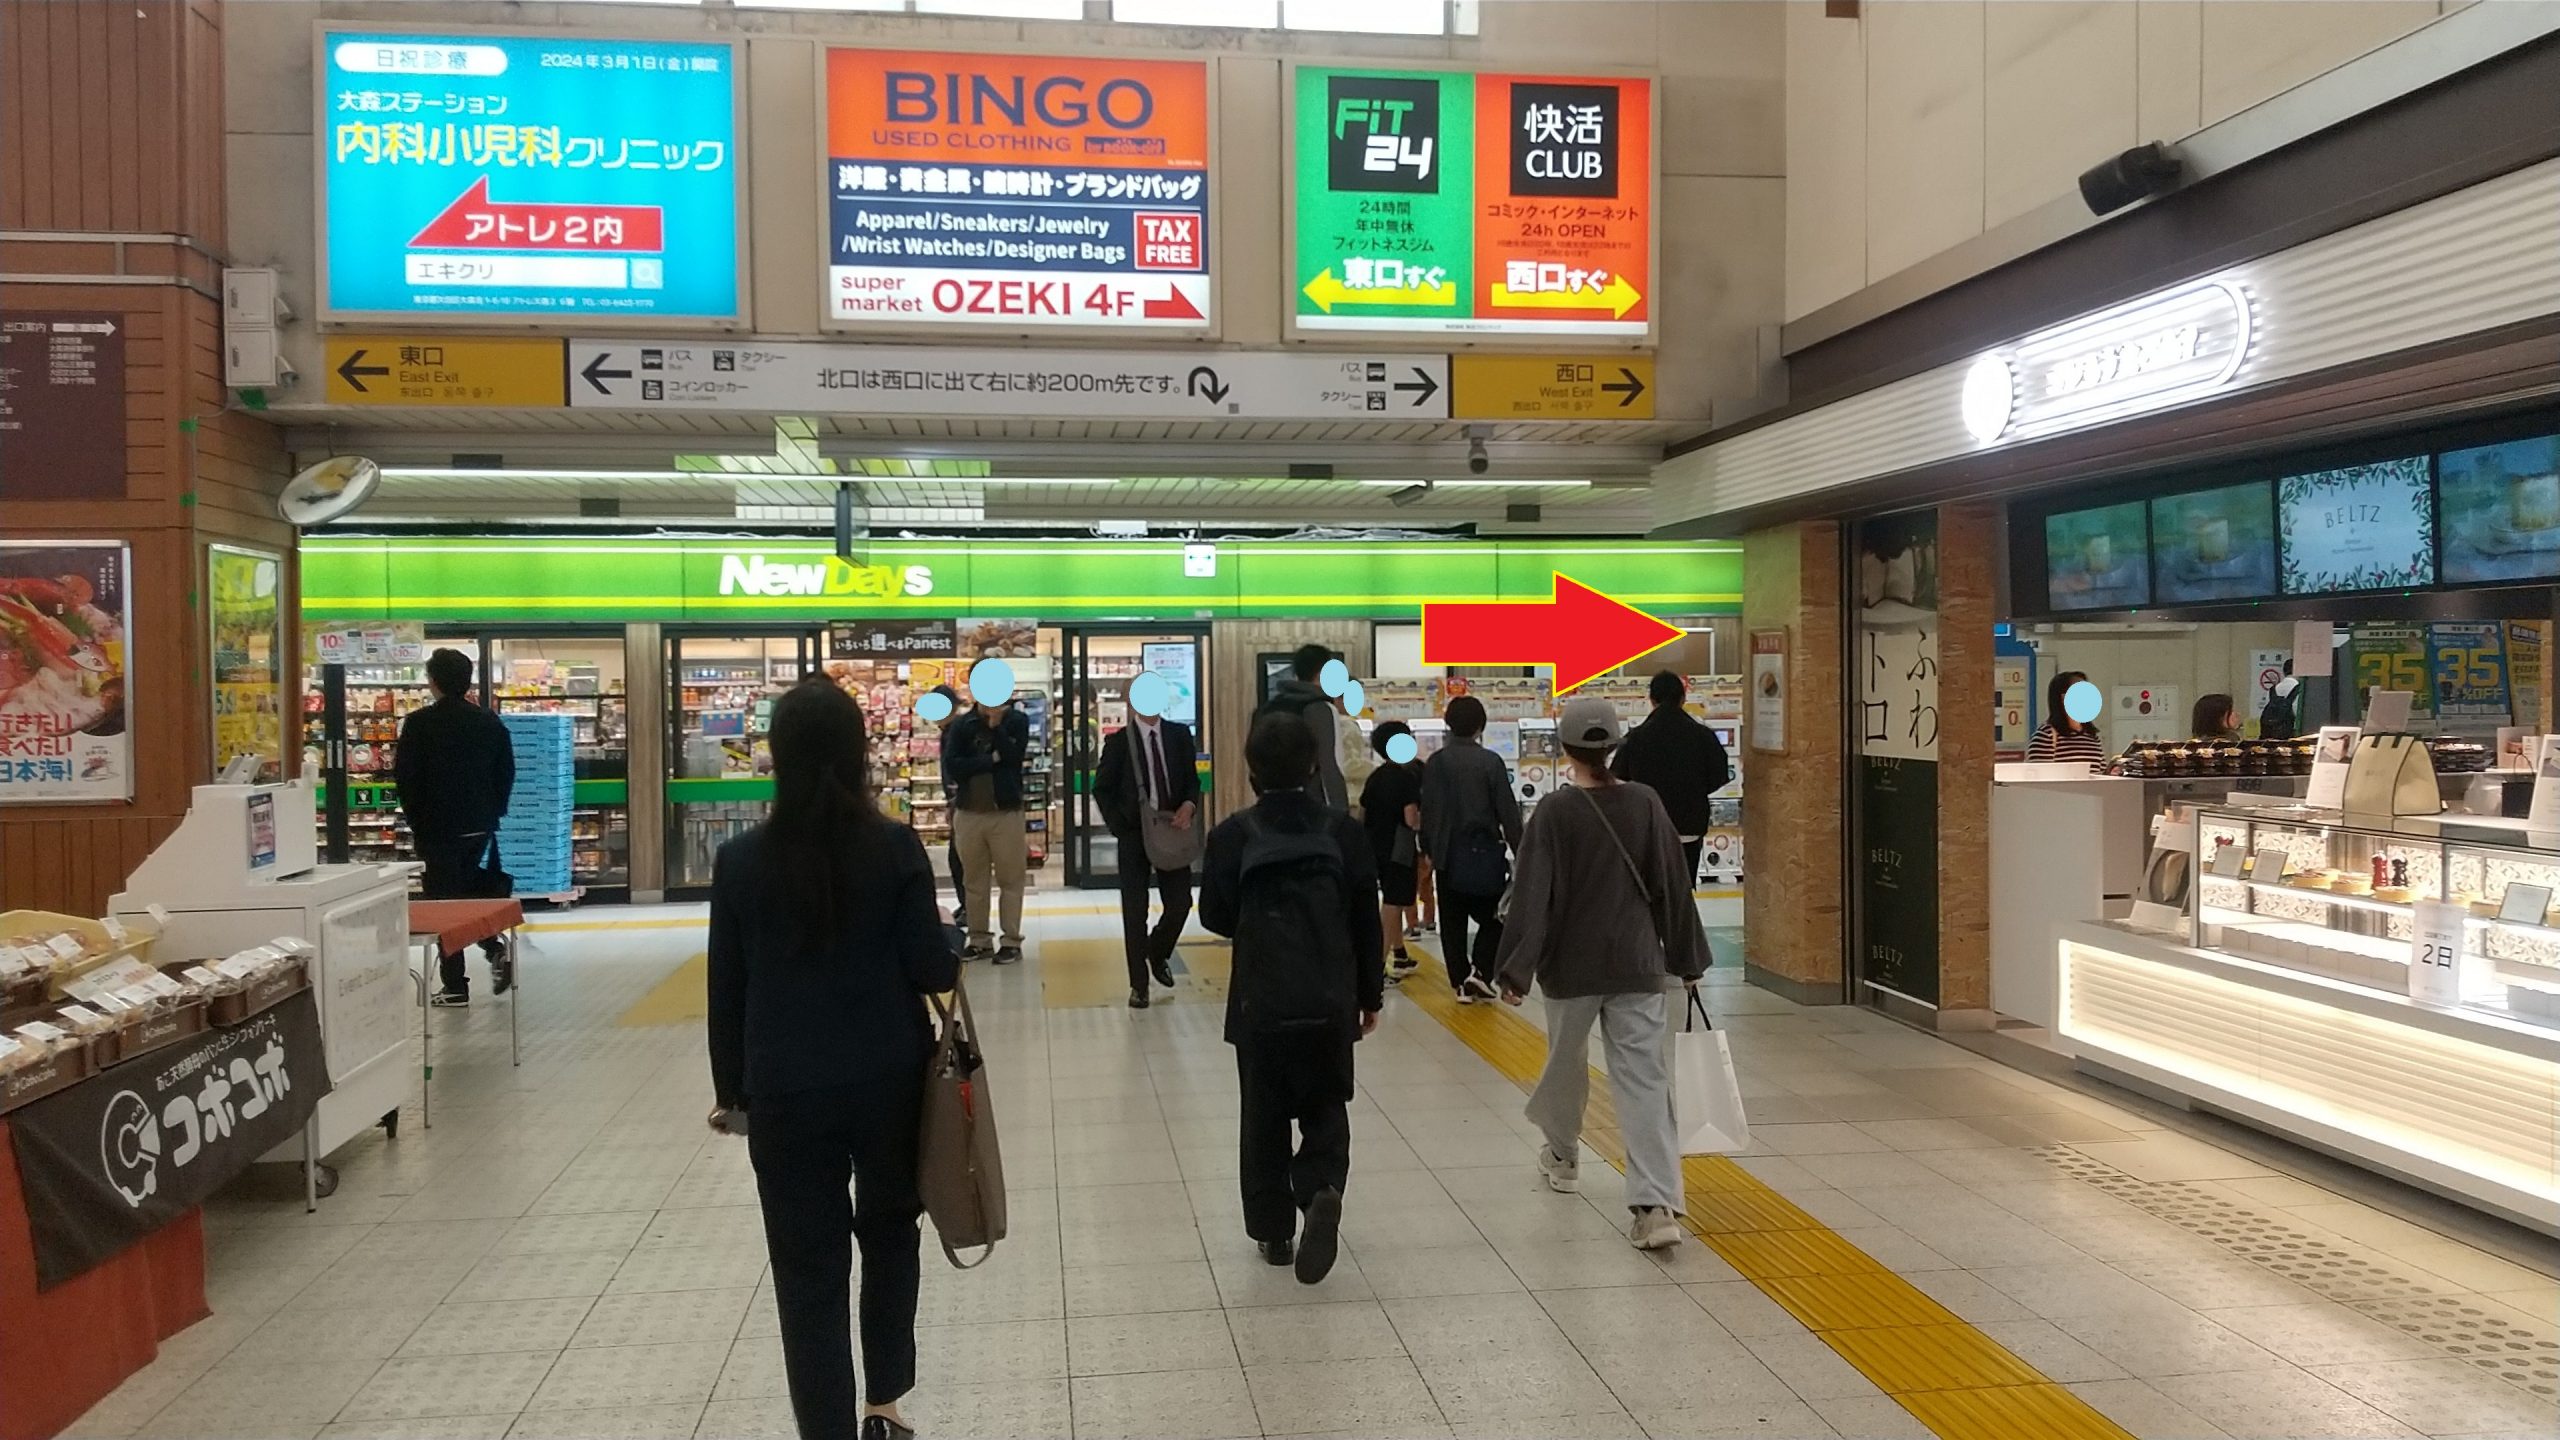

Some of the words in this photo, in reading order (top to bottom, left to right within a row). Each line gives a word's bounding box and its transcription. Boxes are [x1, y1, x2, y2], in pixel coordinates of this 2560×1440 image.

[377, 49, 468, 70] 日祝診療
[337, 91, 507, 115] 大森ステーション
[885, 71, 1153, 129] BINGO
[1523, 103, 1603, 145] 快活
[337, 121, 725, 171] 内科小児科クリニック
[872, 130, 938, 148] USED
[947, 132, 1072, 152] CLOTHING
[1363, 135, 1433, 180] 24
[1526, 150, 1602, 179] CLUB
[1359, 200, 1411, 216] 24時間
[1488, 203, 1639, 221] コミック・インターネット
[465, 214, 623, 244] アトレ2内
[856, 210, 1110, 239] Apparel/Sneakers/Jewelry
[1143, 218, 1192, 242] TAX
[1356, 218, 1415, 234] 年中無休
[1521, 223, 1553, 237] 24h
[1558, 224, 1606, 238] OPEN
[841, 234, 901, 255] /Wrist
[904, 236, 1077, 263] Watches/Designer
[1081, 242, 1126, 265] Bags
[1145, 245, 1192, 264] FREE
[1332, 236, 1434, 252] フィットネスジム
[418, 262, 494, 280] エキクリ
[1343, 256, 1446, 290] 東口すぐ
[1506, 260, 1608, 293] 西口すぐ
[841, 276, 905, 293] super
[841, 296, 922, 312] market
[932, 278, 1071, 316] OZEKI
[1084, 282, 1135, 317] 4F
[399, 346, 443, 366] 東口
[669, 350, 692, 360] バス
[741, 352, 787, 362] タクシー
[400, 371, 429, 382] East
[434, 371, 459, 383] Exit
[1340, 362, 1361, 373] バス
[1556, 364, 1593, 382] 西口
[669, 381, 749, 392] コインロッカー
[817, 368, 1181, 395] 北口は西口に出て右に約200m先です。
[1539, 386, 1569, 398] West
[1572, 386, 1593, 398] Exit
[1321, 391, 1361, 402] タクシー
[2324, 504, 2381, 529] BELTZ
[719, 555, 933, 598] NewDays
[2358, 653, 2426, 690] 35
[2437, 648, 2499, 687] 35
[1862, 632, 1889, 746] トロ
[1906, 628, 1939, 749] ふわ
[1871, 849, 1902, 868] BELTZ
[1872, 945, 1903, 967] BELTZ
[2421, 943, 2453, 969] 2日
[163, 1031, 291, 1168] コボコボ
